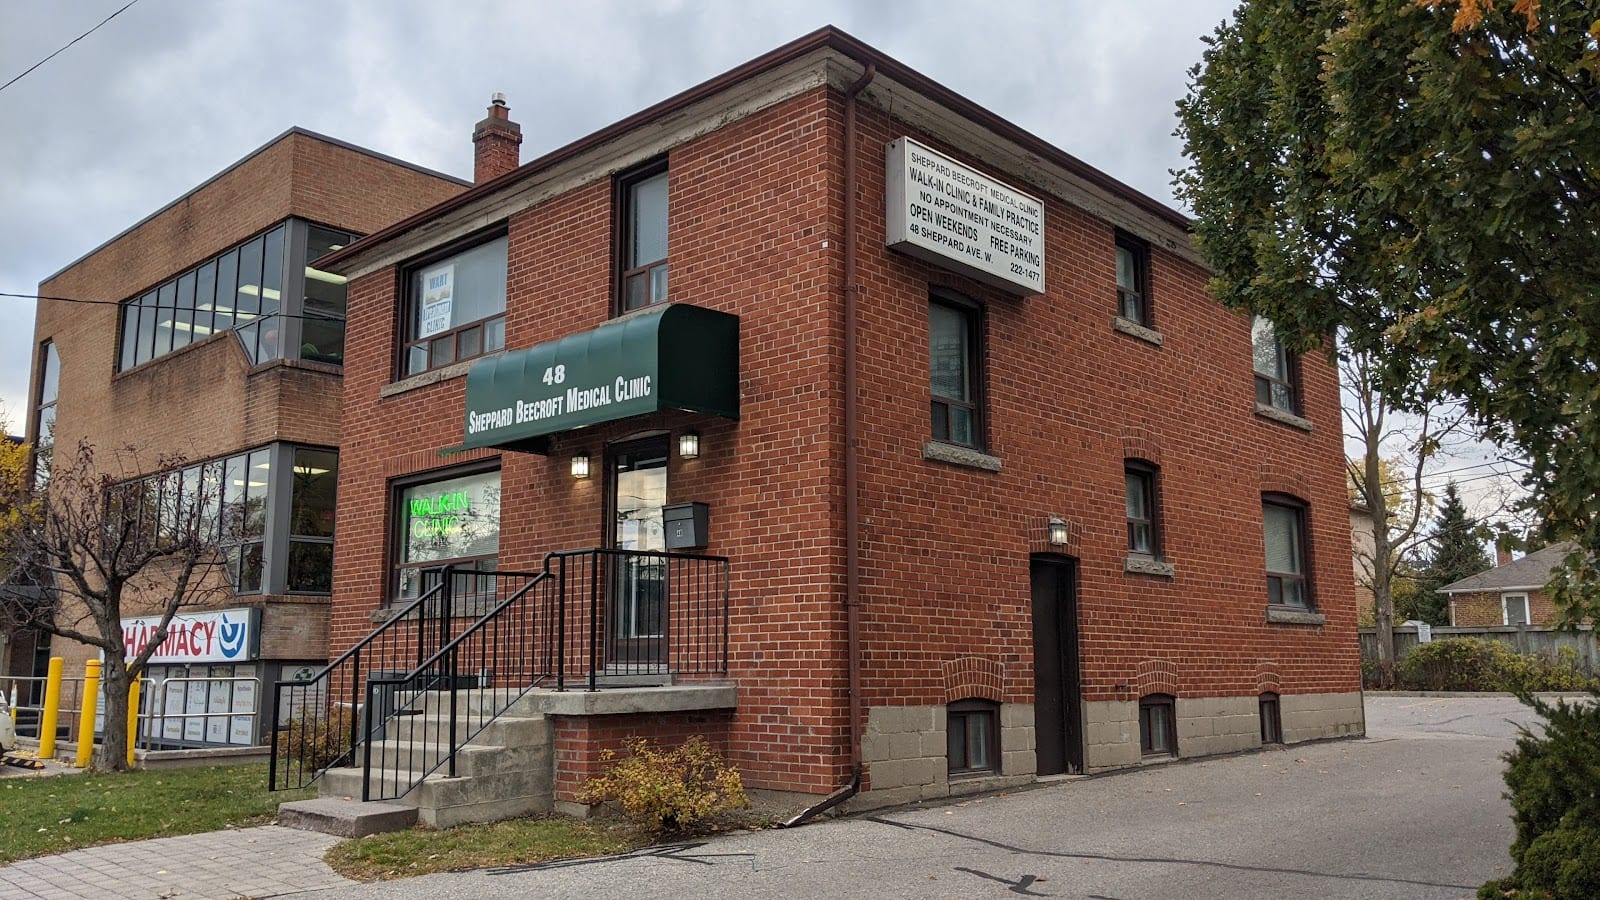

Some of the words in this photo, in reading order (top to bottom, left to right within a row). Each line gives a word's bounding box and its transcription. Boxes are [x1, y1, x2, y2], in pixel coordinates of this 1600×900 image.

[909, 166, 944, 193] WALK-IN
[945, 183, 971, 205] CLINIC
[972, 194, 977, 208] &
[979, 197, 1005, 220] FAMILY
[1006, 209, 1039, 236] PRACTICE
[911, 152, 951, 178] SHEPPARD
[952, 170, 988, 194] BEECROFT
[990, 188, 1018, 209] MEDICAL
[1019, 202, 1039, 218] CLINIC
[910, 203, 933, 224] OPEN
[935, 211, 978, 242] WEEKENDS
[990, 235, 1009, 255] FREE
[1010, 243, 1040, 267] PARKING
[919, 190, 932, 204] NO
[934, 196, 989, 228] APPOINTMENT
[990, 220, 1032, 247] NECESSARY
[909, 223, 920, 235] 48
[921, 226, 964, 252] SHEPPARD
[966, 245, 983, 260] AVE.
[984, 251, 994, 264] W.
[1010, 262, 1040, 283] 222-1477
[429, 273, 448, 290] WART
[426, 317, 445, 334] CLINIC
[542, 364, 566, 386] 48
[468, 407, 513, 435] SHEPPARD
[515, 395, 564, 424] BEECROFT
[566, 384, 612, 414] MEDICAL
[614, 375, 651, 403] CLINIC
[410, 490, 470, 516] WALK-IN
[413, 516, 461, 538] CLINIC
[122, 620, 216, 658] HARMACY
